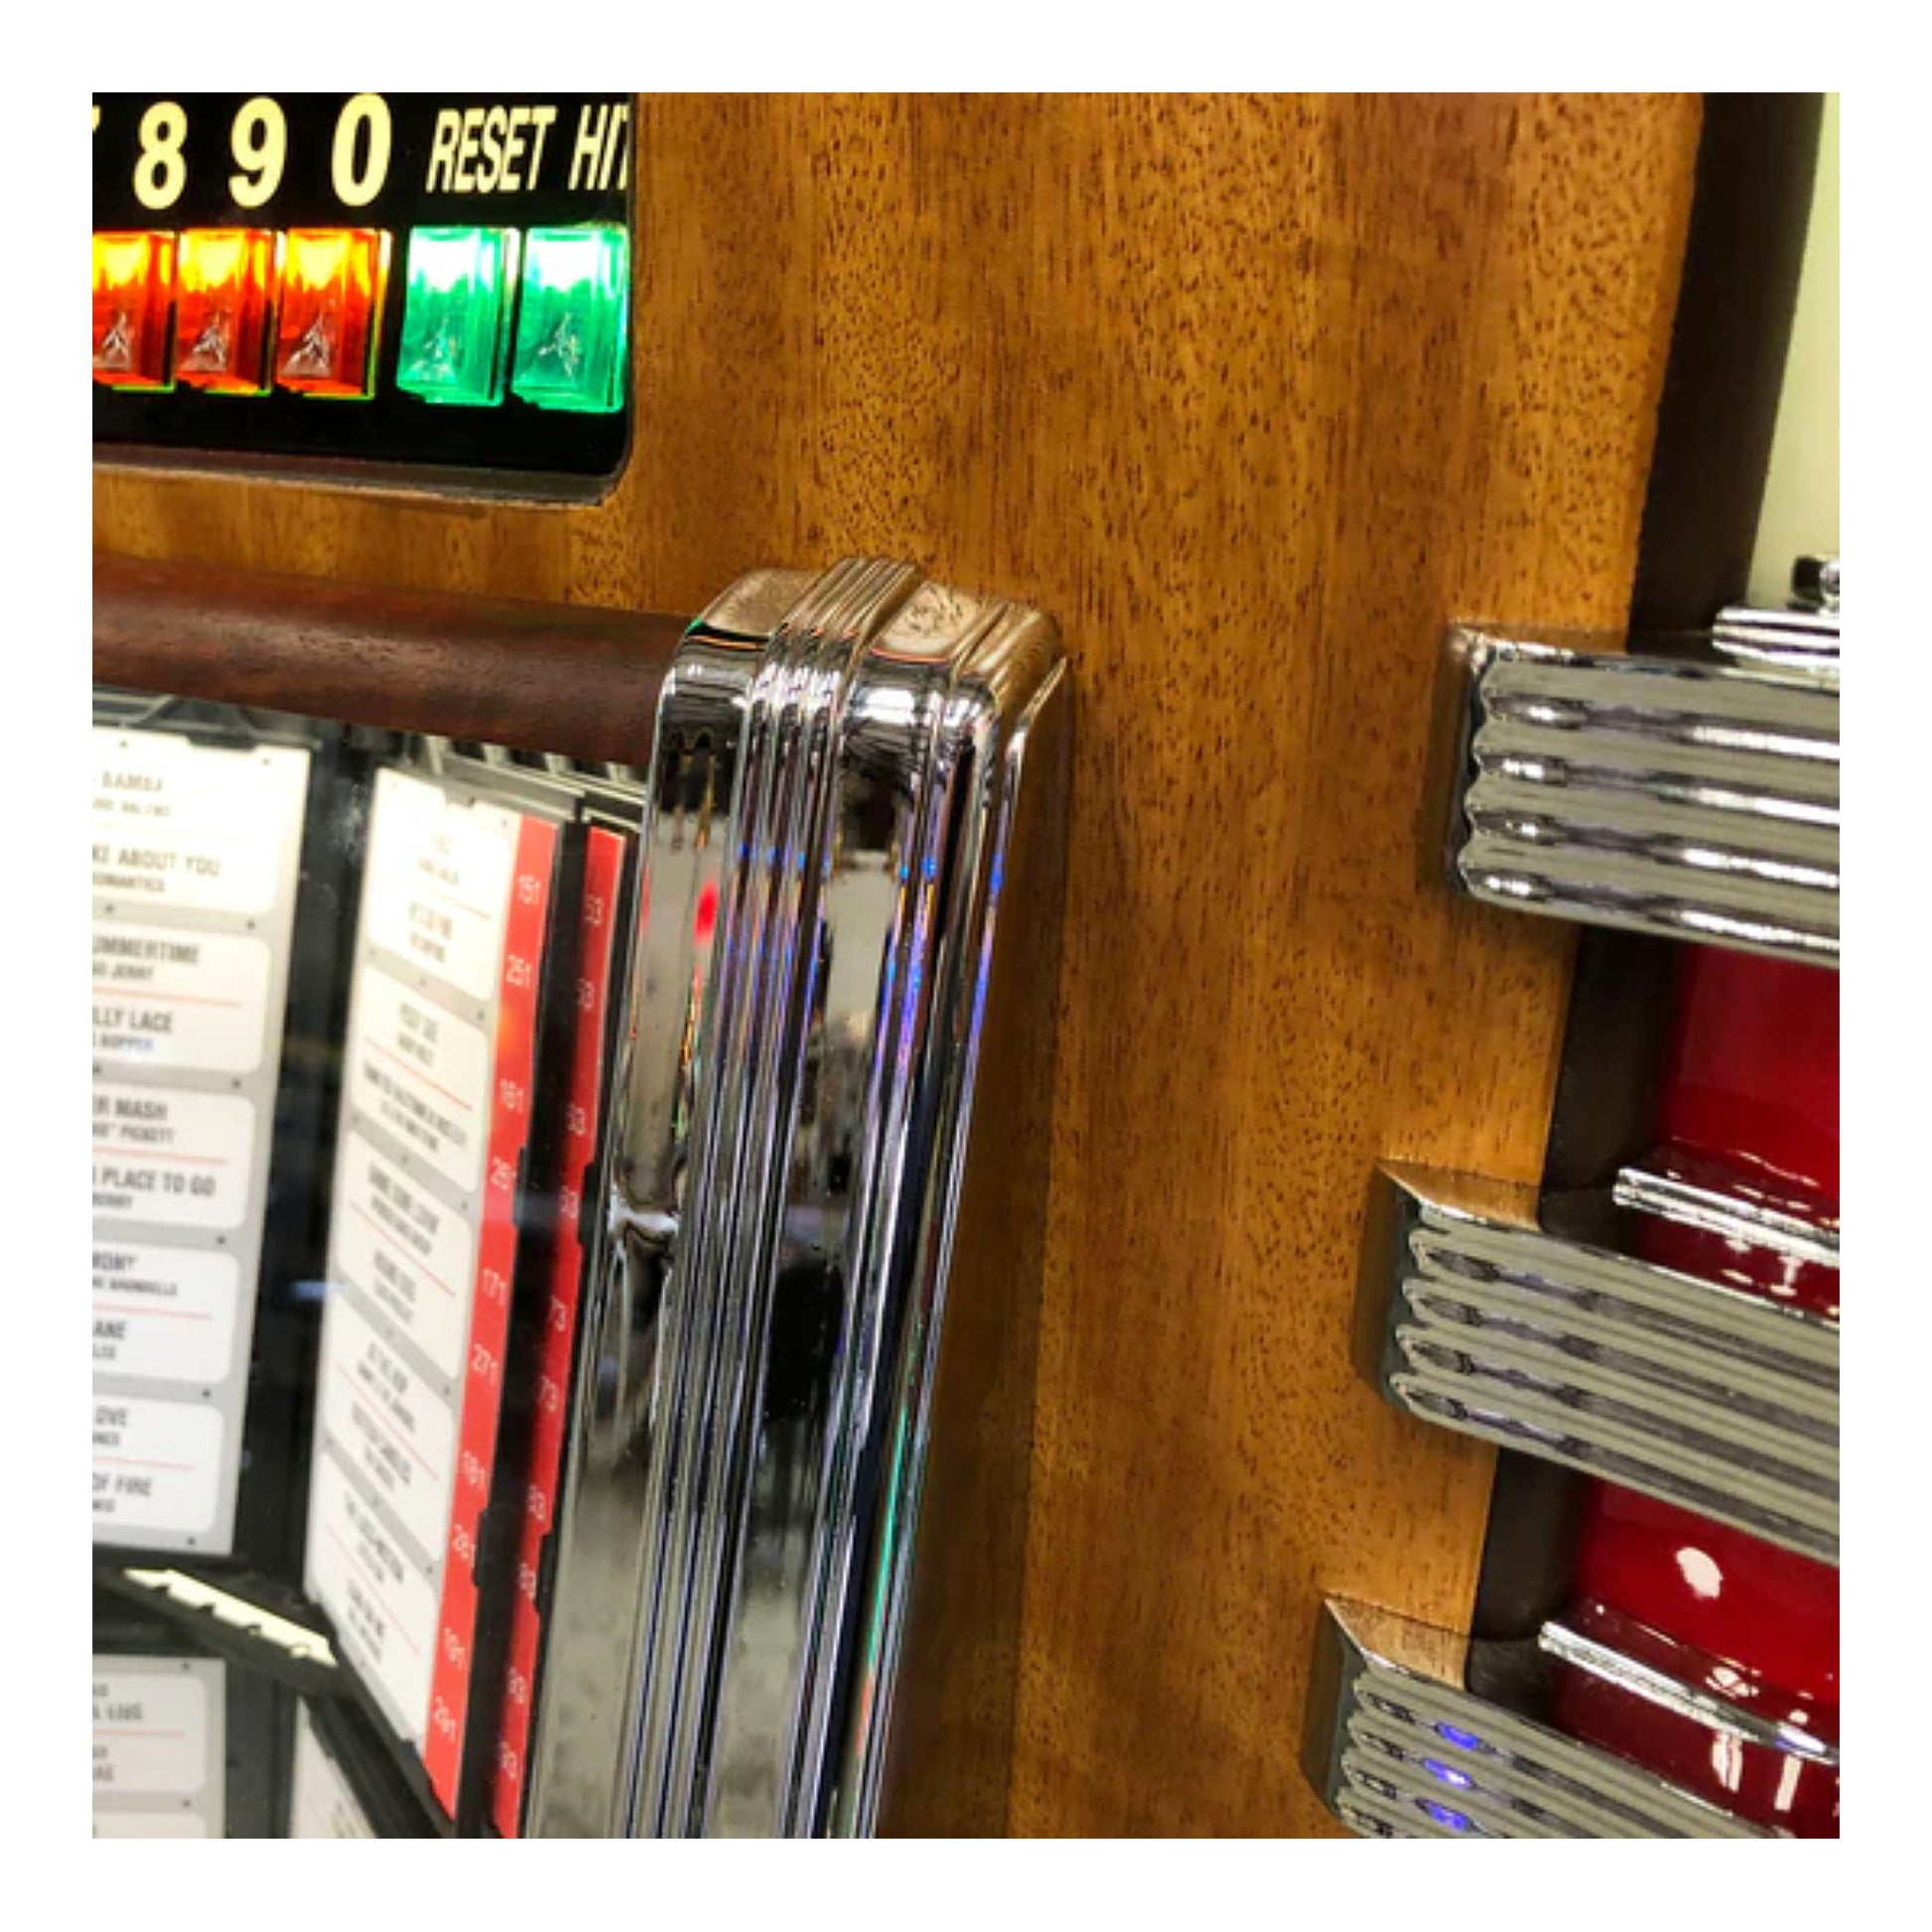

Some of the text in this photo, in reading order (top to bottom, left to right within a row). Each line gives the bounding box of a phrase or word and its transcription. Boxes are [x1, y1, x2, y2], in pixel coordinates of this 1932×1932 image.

[133, 101, 188, 208] 8
[228, 97, 288, 207] 9
[331, 92, 392, 207] 0
[426, 106, 558, 193] RESET
[118, 848, 176, 871] ABOUT
[184, 855, 221, 876] YOU
[111, 963, 154, 981] JERRY
[504, 954, 532, 989] 251
[129, 1010, 172, 1032] LACE
[115, 1099, 168, 1120] MASH
[101, 1166, 216, 1196] PLACE TO GO
[483, 1269, 506, 1307] 171
[472, 1343, 497, 1385] 271
